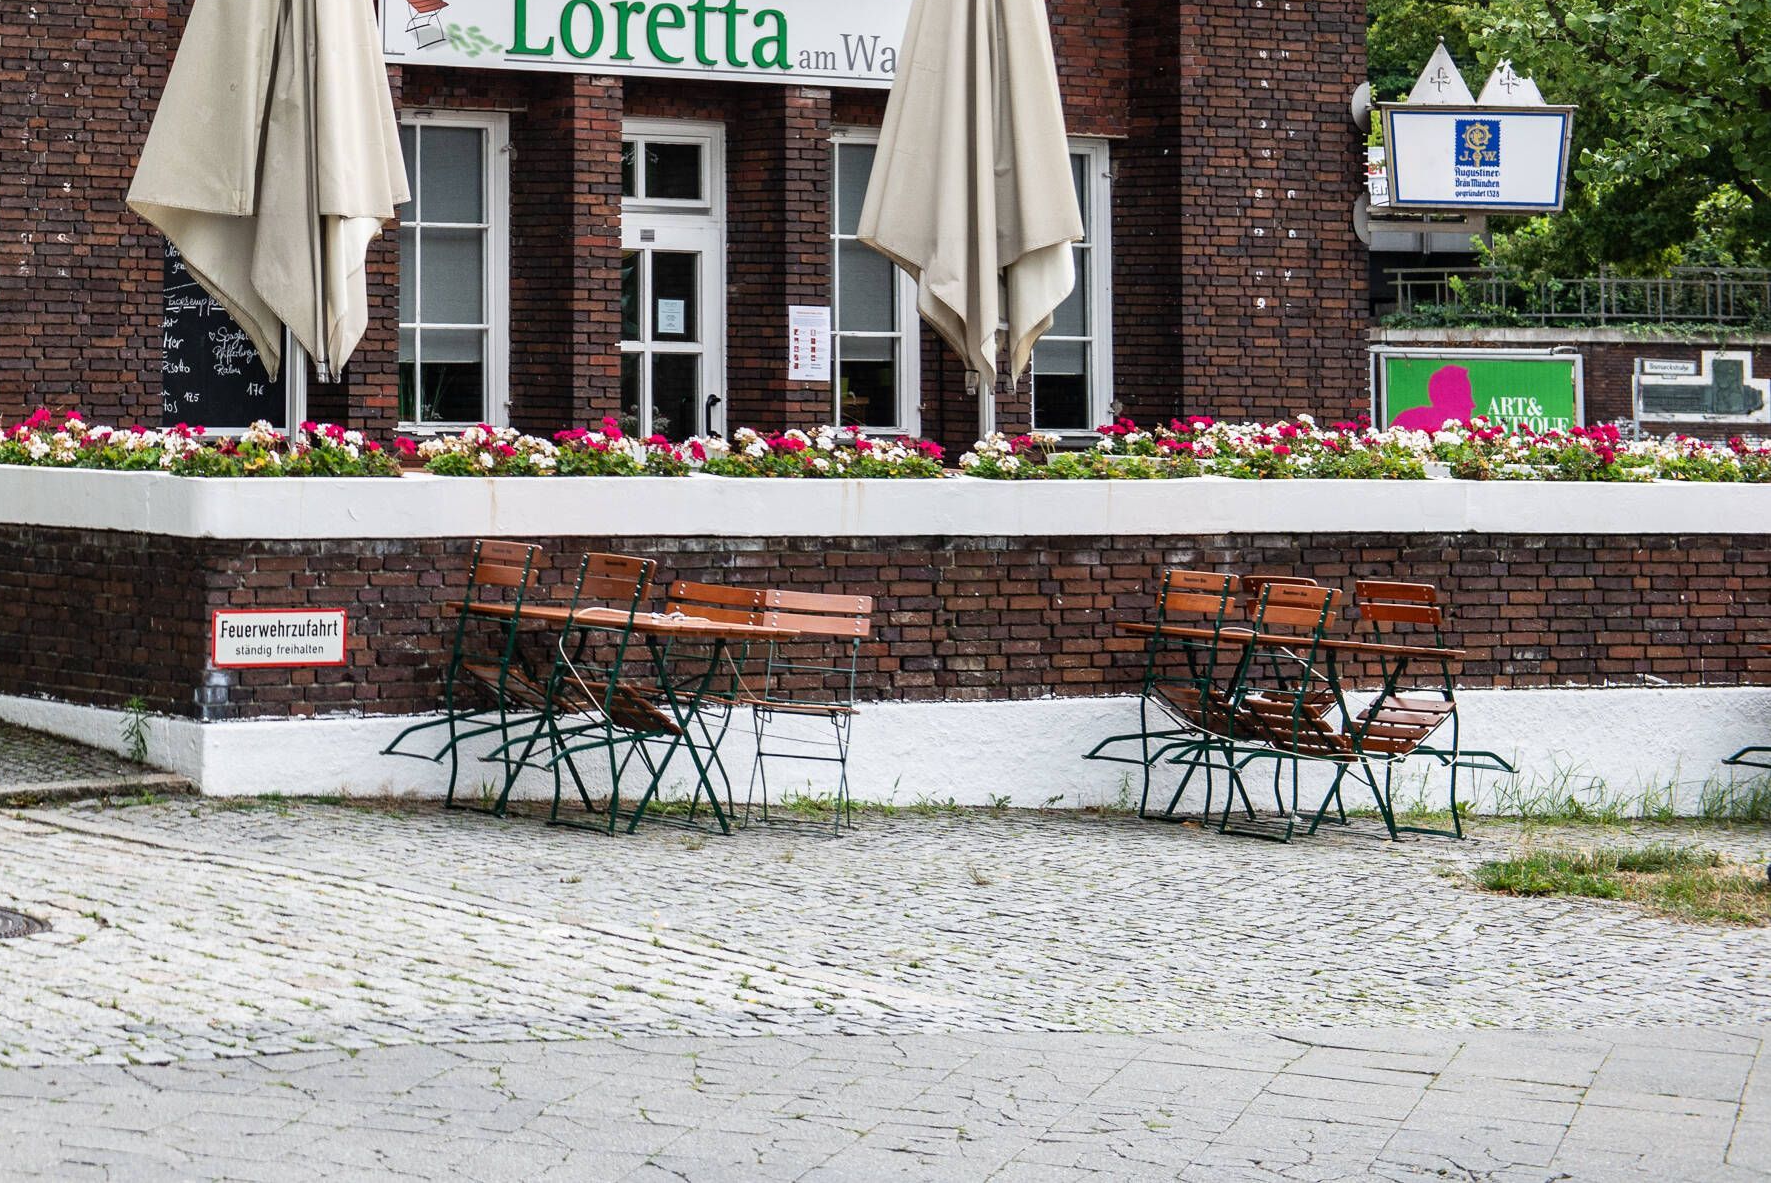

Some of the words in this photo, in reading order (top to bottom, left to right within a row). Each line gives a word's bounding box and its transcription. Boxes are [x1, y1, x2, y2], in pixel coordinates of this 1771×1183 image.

[799, 46, 836, 71] am
[840, 33, 897, 75] Wa
[220, 619, 338, 638] Feuerwehrzufahrt
[235, 644, 272, 657] ständig
[276, 643, 324, 655] freihalten
